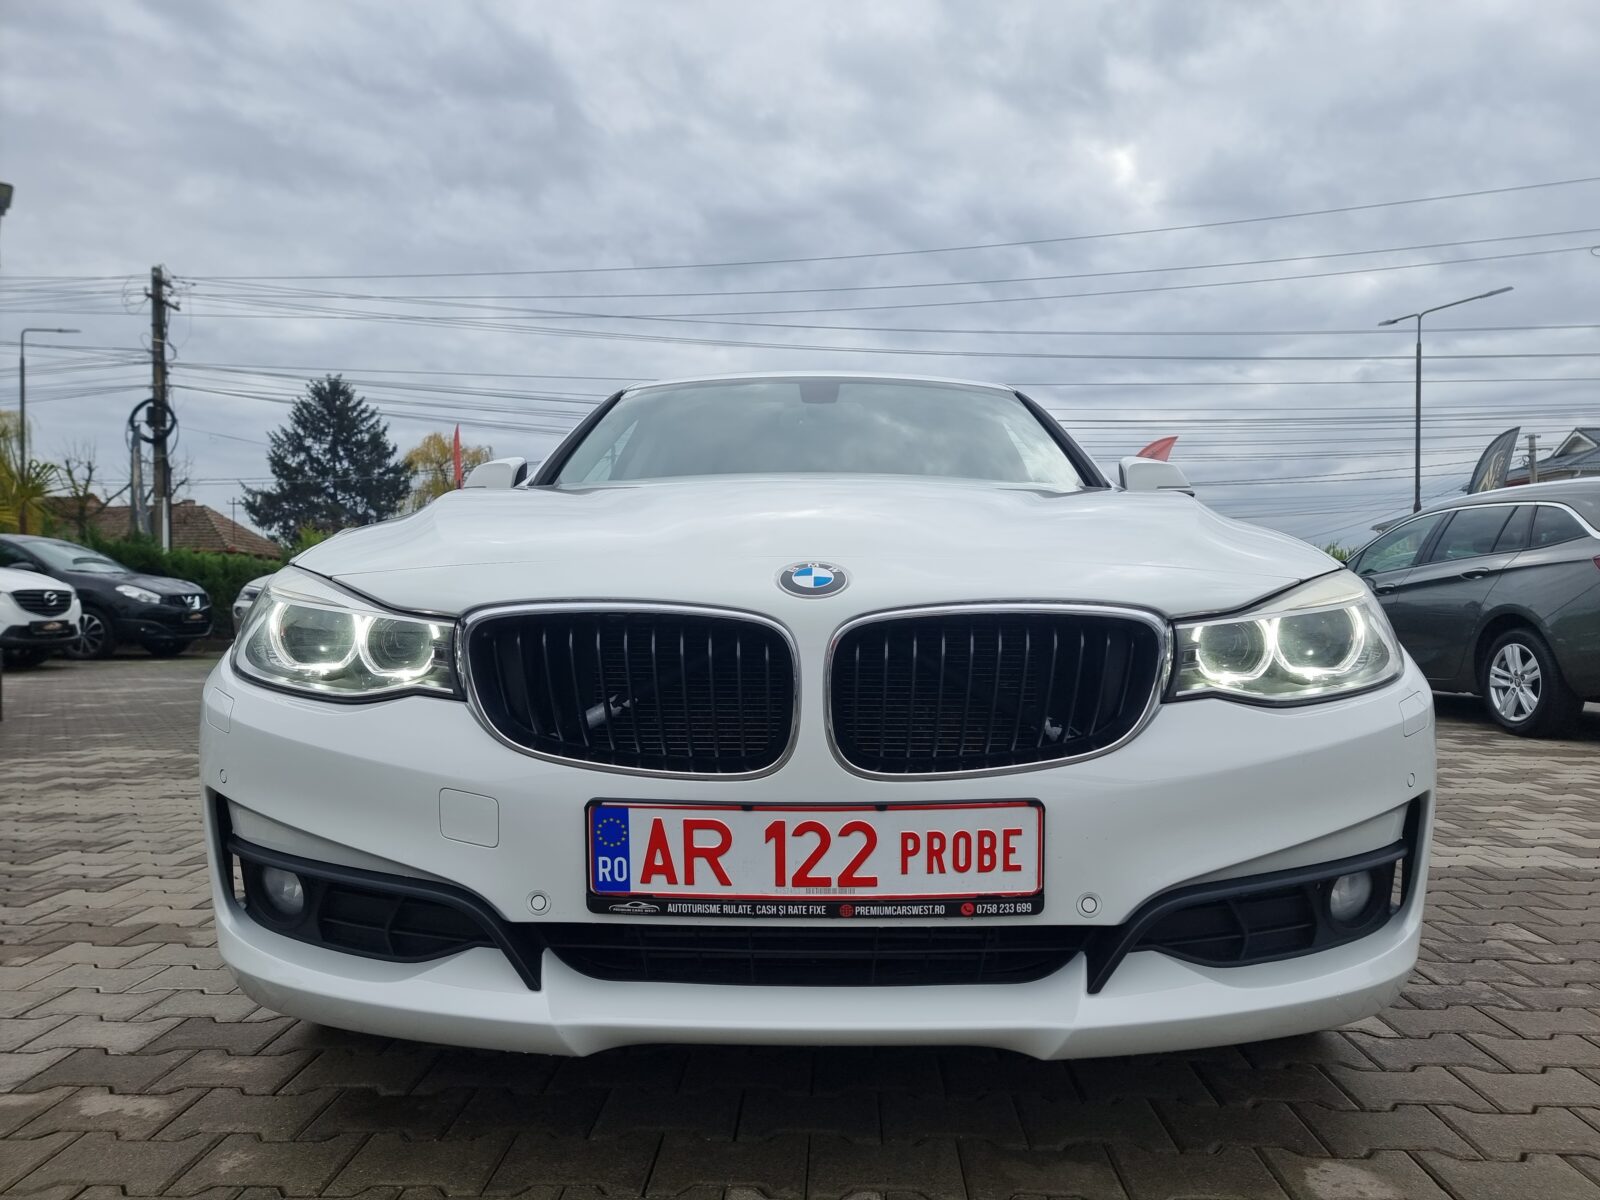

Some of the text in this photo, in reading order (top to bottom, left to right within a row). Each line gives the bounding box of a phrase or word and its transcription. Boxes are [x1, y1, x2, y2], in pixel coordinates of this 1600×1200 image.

[640, 817, 1022, 887] AR 122 PROBE
[598, 856, 627, 882] RO
[667, 903, 721, 914] AUTOTURISME
[722, 904, 754, 916] RULATE,
[756, 905, 777, 915] CASH
[789, 905, 807, 915] RATE
[809, 905, 827, 915] FIXE
[855, 904, 945, 915] PREMIUMCARSWEST.RO
[976, 902, 1032, 914] 0758 233 699
